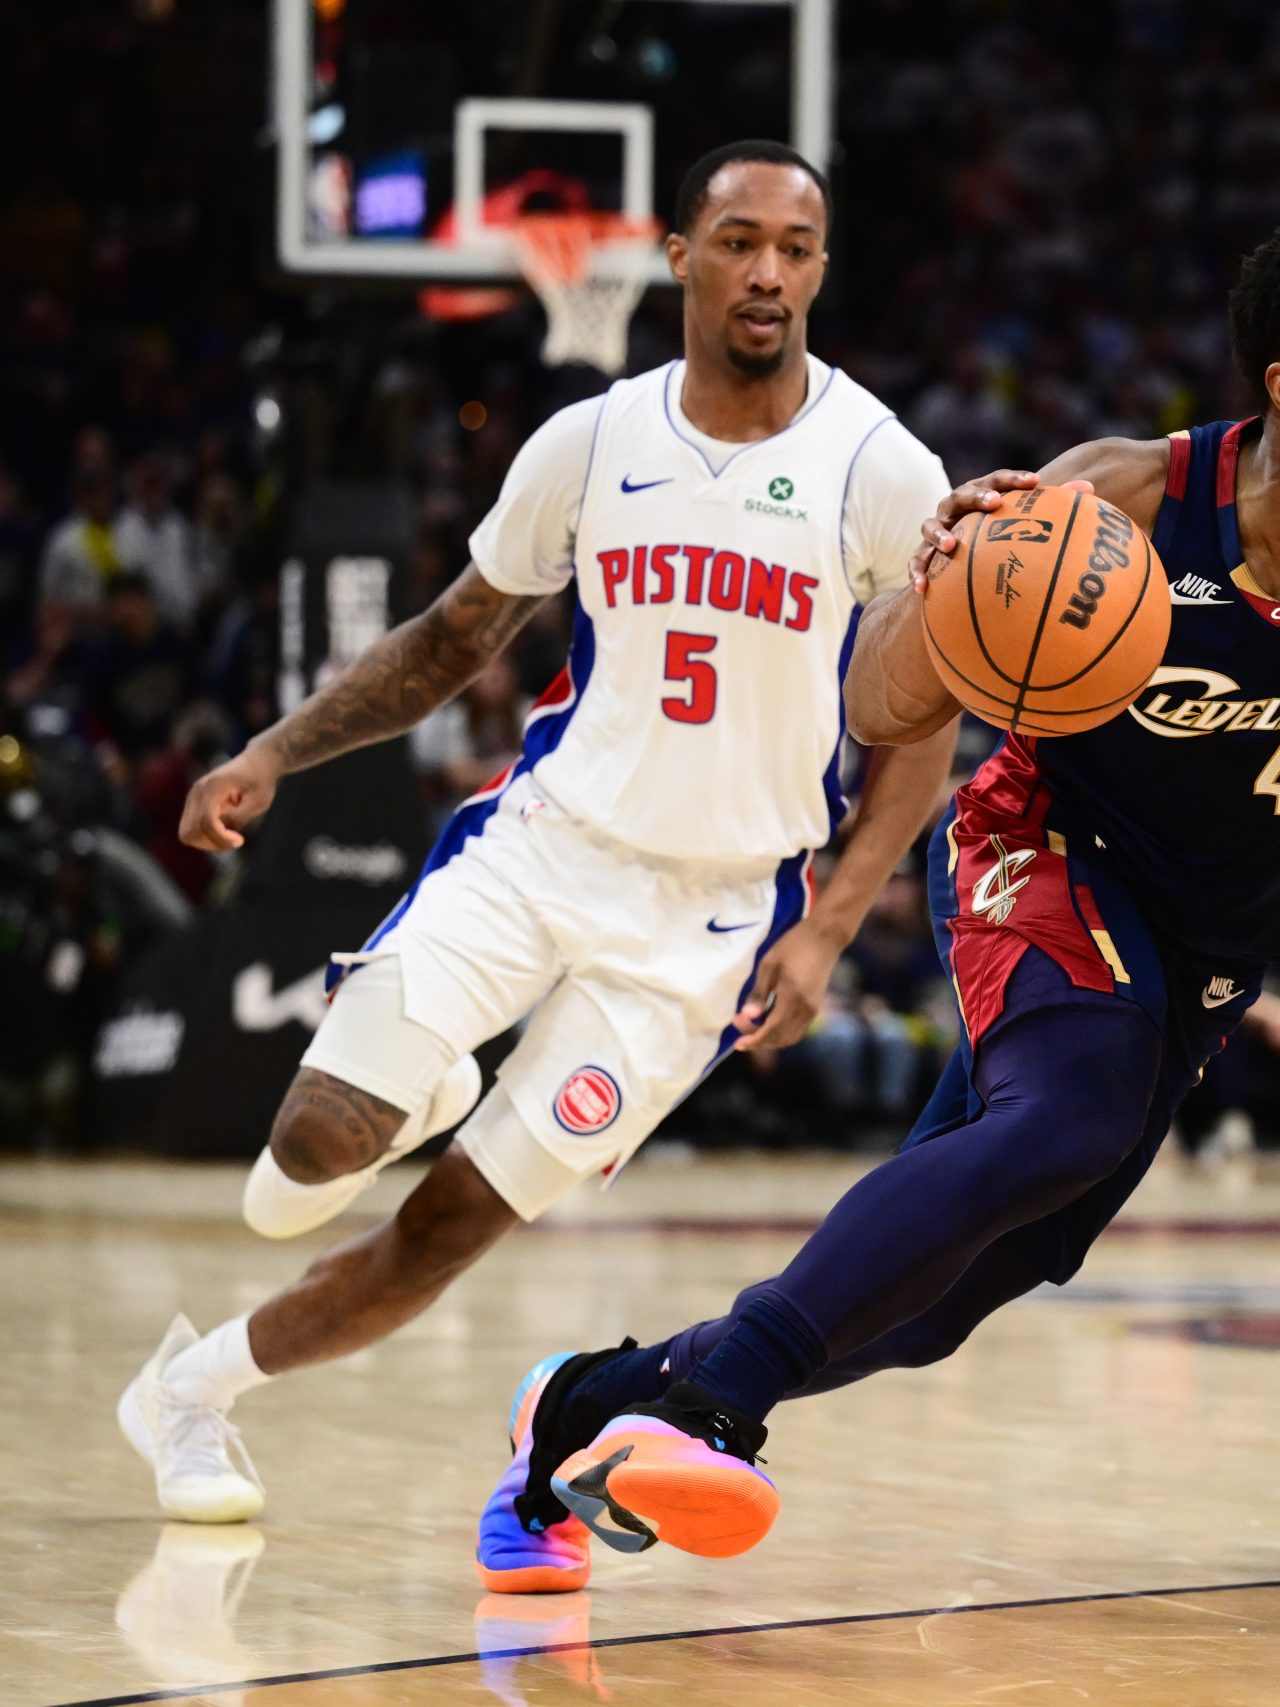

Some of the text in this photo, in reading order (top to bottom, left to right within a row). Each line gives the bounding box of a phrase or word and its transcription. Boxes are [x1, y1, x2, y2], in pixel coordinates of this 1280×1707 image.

[596, 544, 820, 633] PISTONS
[1176, 572, 1222, 602] NIKE
[661, 630, 718, 726] 5
[1207, 976, 1235, 998] NIKE
